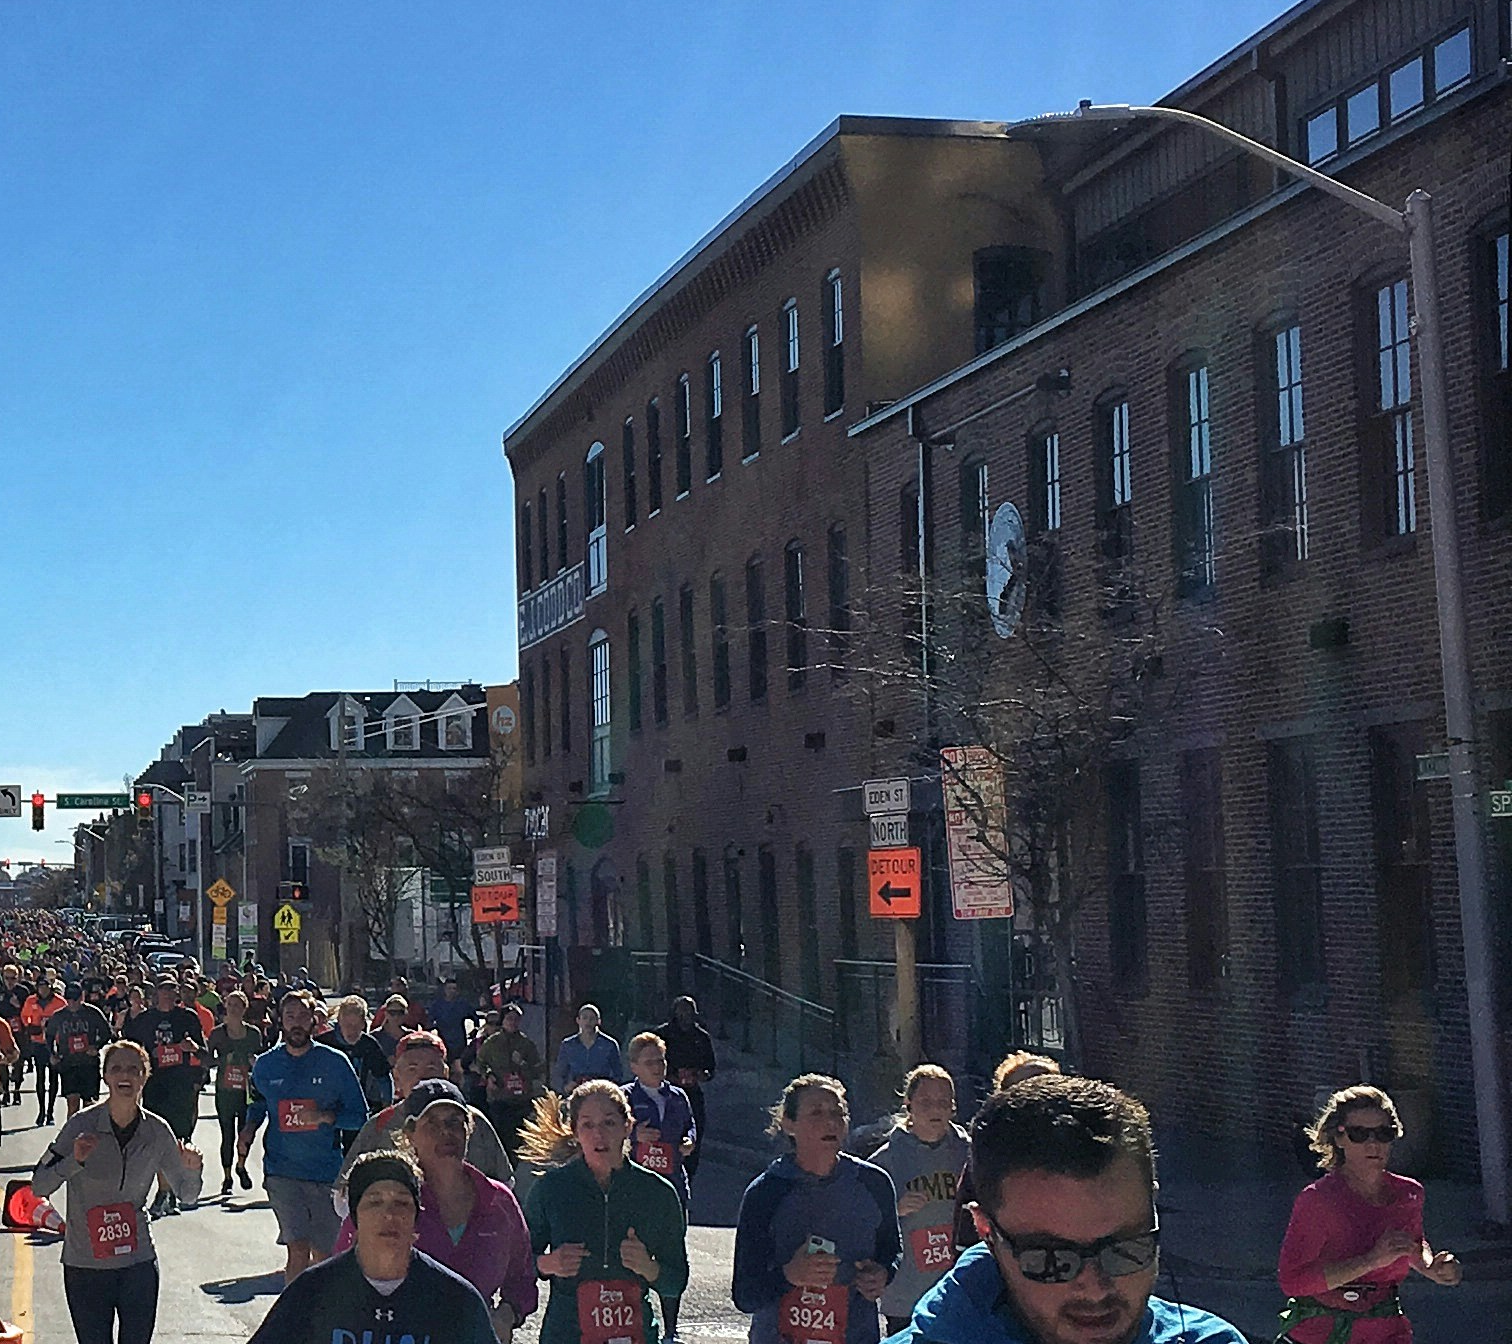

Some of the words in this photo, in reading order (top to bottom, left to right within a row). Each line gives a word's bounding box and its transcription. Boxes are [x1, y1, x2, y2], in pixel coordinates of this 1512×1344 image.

[64, 796, 70, 806] S
[74, 795, 109, 806] Carolina
[868, 790, 891, 805] EDEN
[893, 788, 904, 803] ST
[871, 821, 907, 842] NORTH
[477, 869, 511, 883] SOUTH
[871, 858, 916, 876] DETOUR
[97, 1222, 131, 1242] 2839
[591, 1305, 634, 1327] 1812
[789, 1306, 835, 1331] 3924
